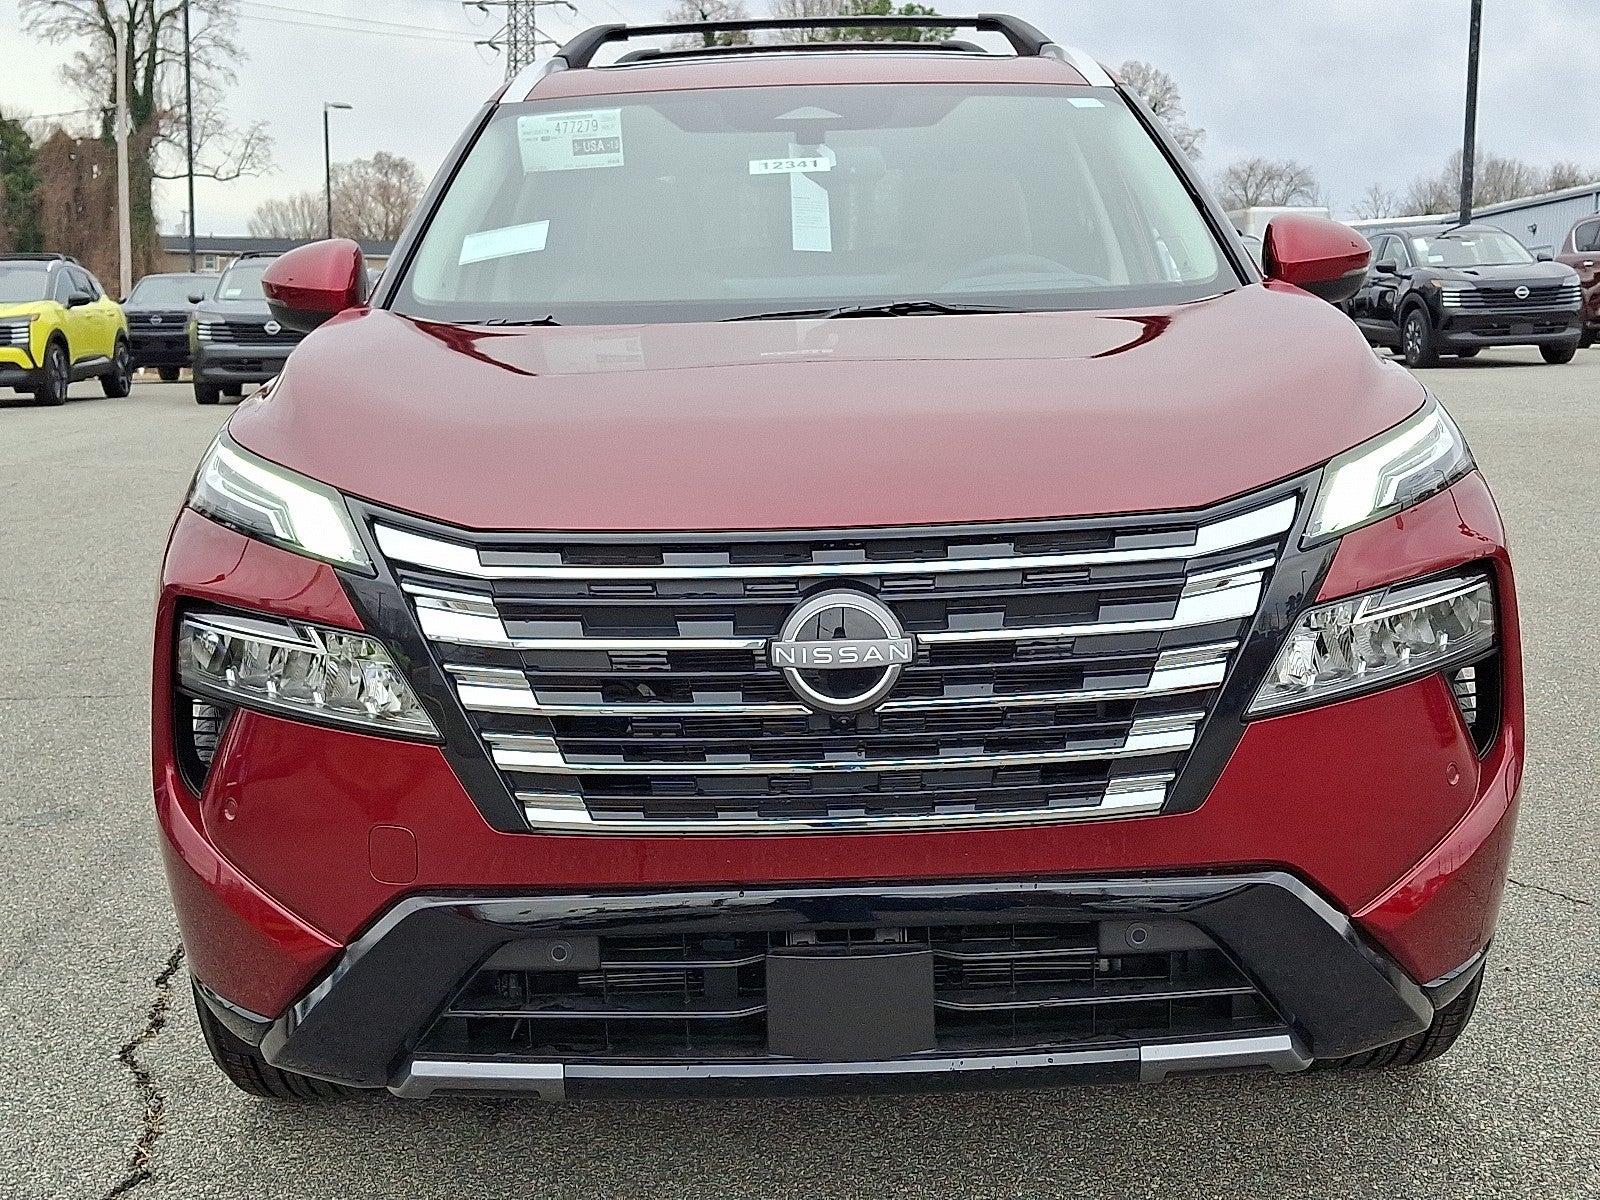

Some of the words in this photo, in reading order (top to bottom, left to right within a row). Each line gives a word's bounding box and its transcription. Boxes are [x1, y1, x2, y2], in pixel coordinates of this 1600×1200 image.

[554, 118, 599, 134] 477279
[582, 139, 605, 152] USA
[760, 159, 818, 170] 12341
[775, 643, 909, 664] NISSAN
